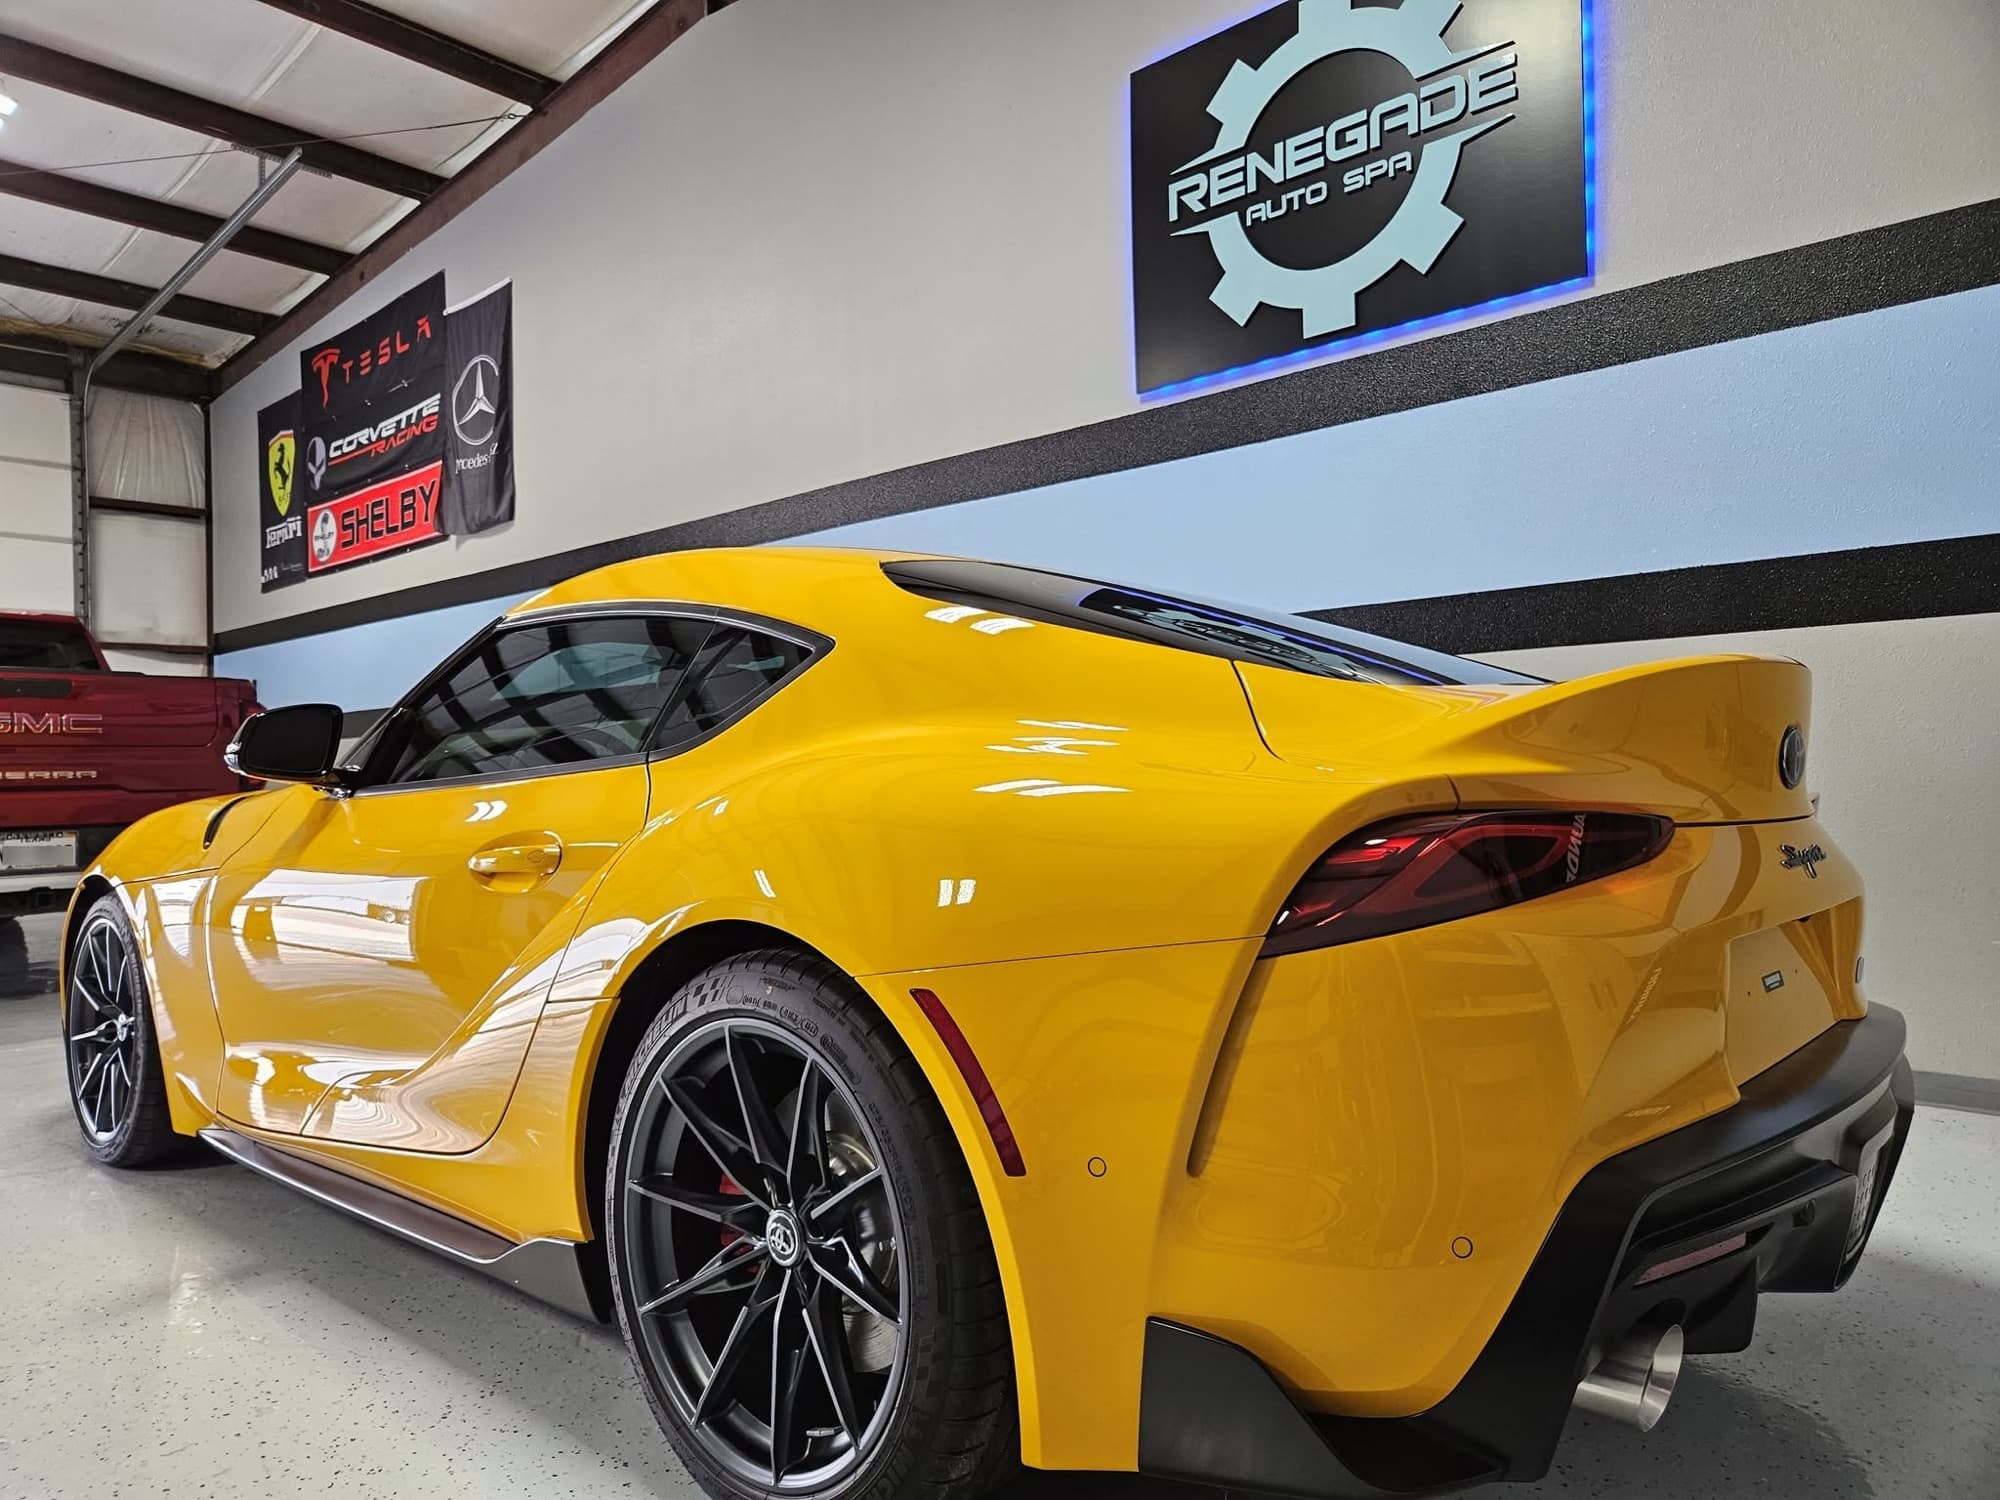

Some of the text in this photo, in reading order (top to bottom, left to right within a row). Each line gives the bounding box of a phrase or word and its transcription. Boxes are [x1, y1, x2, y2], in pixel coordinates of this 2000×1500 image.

[1167, 53, 1518, 223] RENEGADE
[1246, 150, 1413, 227] AUTO SPA
[342, 315, 432, 384] TESLA
[328, 392, 441, 458] CORVETTE
[371, 414, 439, 457] RACING
[265, 515, 303, 549] Ferrari
[341, 480, 436, 549] SHELBY
[0, 770, 97, 780] ERRA
[1779, 843, 1826, 880] Supra
